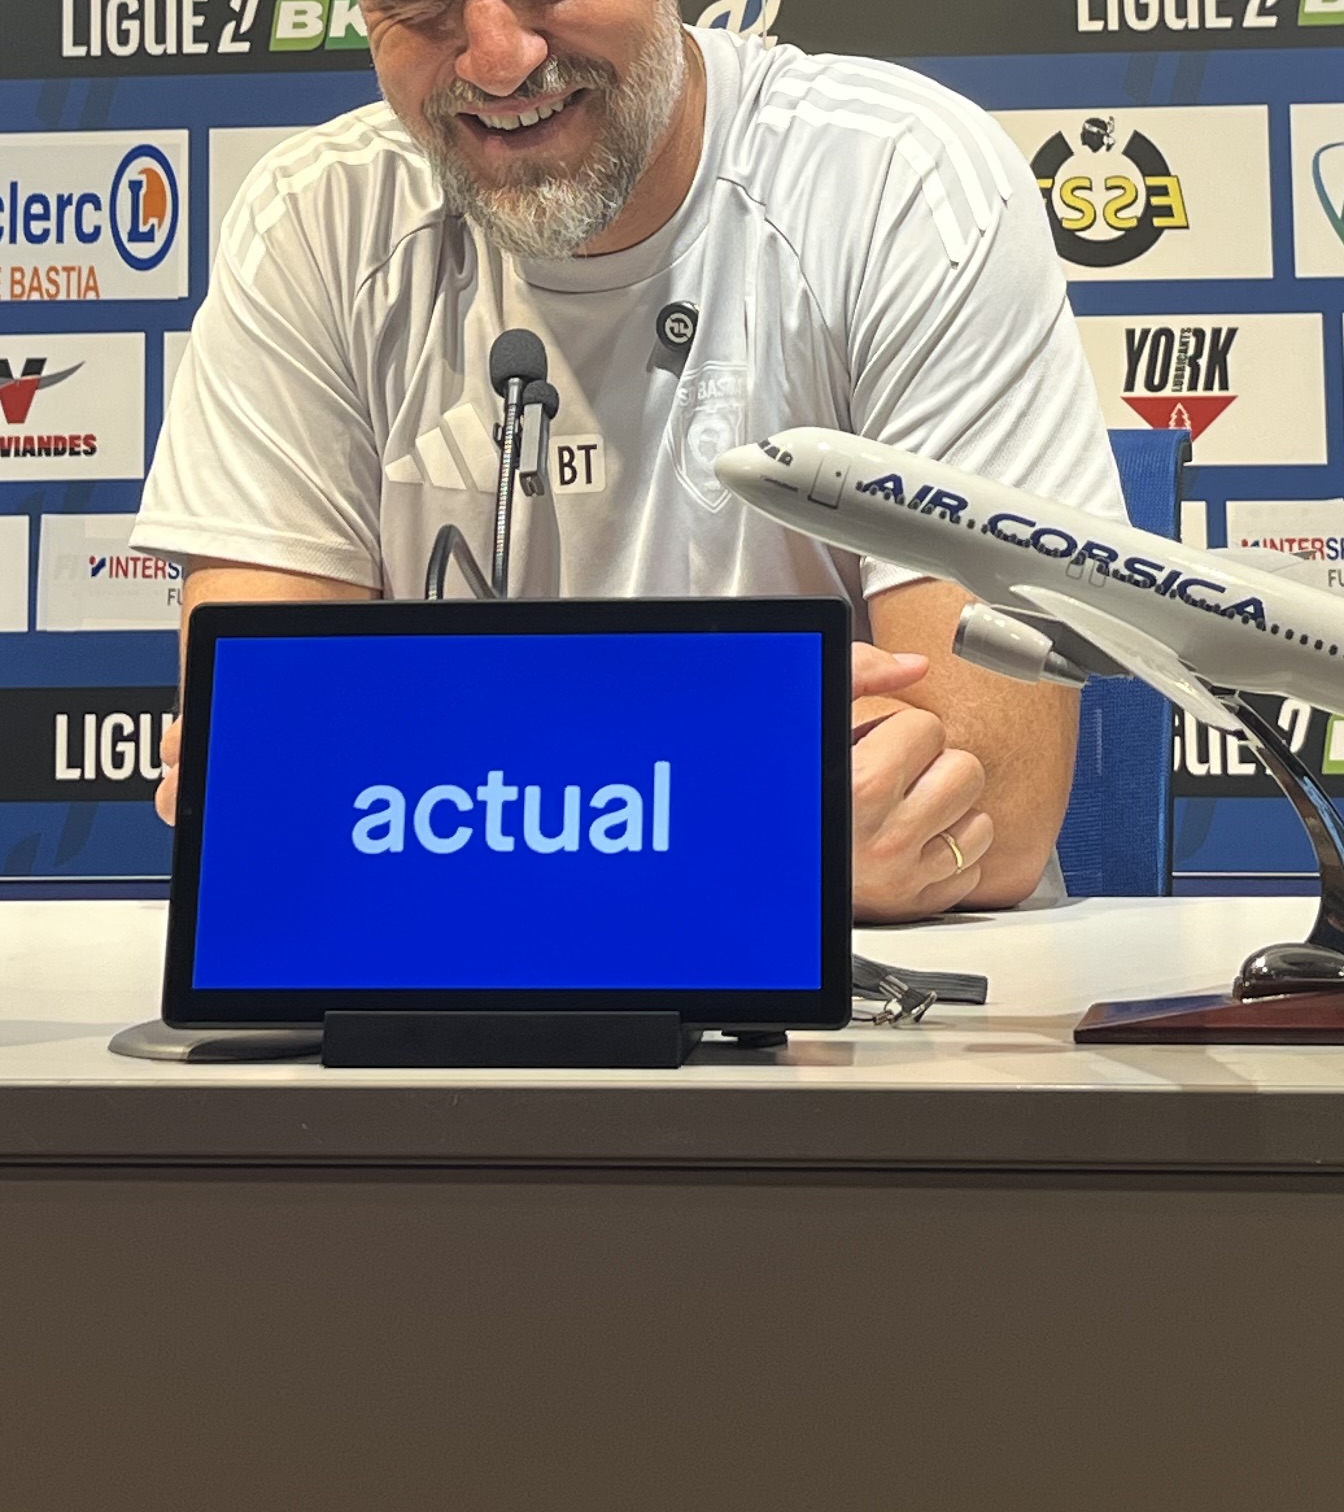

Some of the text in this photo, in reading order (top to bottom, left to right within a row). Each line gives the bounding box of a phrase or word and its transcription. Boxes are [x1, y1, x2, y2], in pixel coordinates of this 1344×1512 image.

[11, 265, 100, 300] BASTIA
[1124, 328, 1238, 392] YORK
[0, 435, 96, 457] VIANDES
[558, 444, 597, 485] BT
[859, 472, 1266, 627] AIR CORSICA
[352, 761, 670, 854] actual
